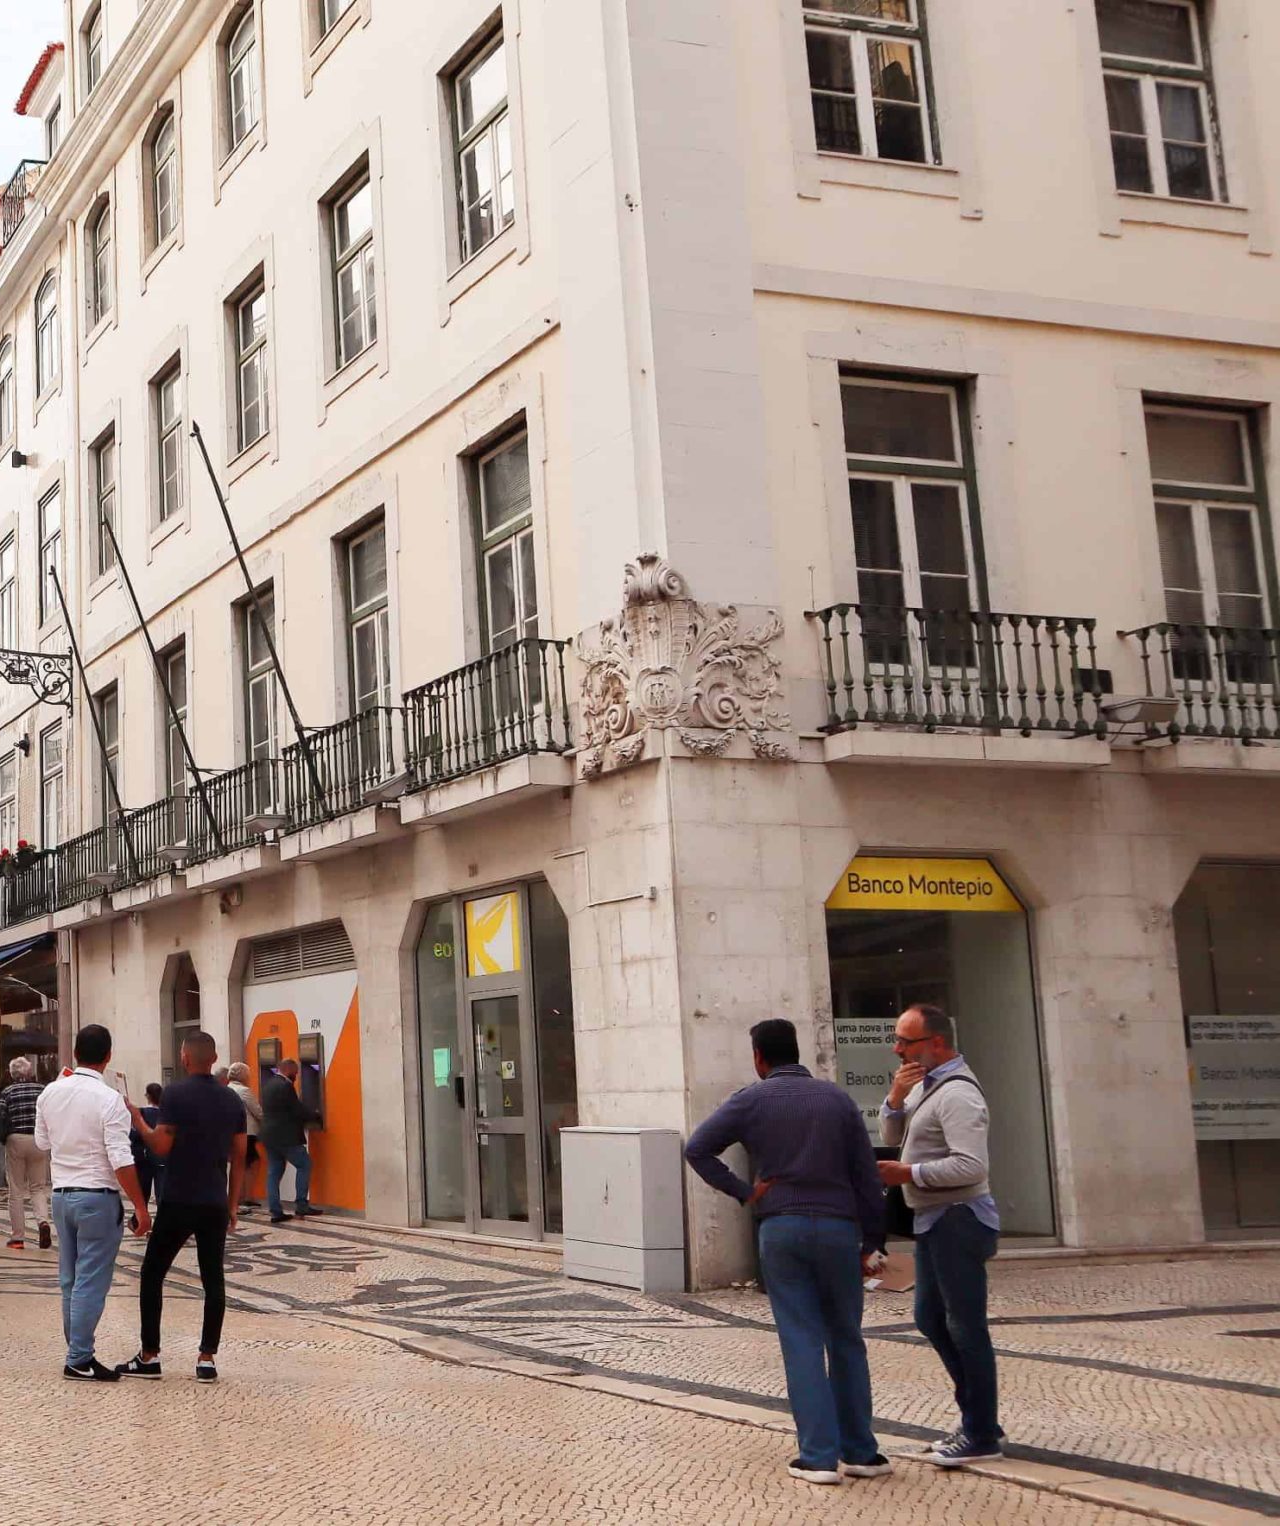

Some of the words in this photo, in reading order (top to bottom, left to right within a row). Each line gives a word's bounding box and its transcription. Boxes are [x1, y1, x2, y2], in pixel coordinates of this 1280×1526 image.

[847, 873, 904, 894] Banco
[908, 874, 994, 901] Montepio
[836, 1024, 857, 1033] uma
[859, 1024, 882, 1033] nova
[850, 1034, 882, 1045] valores
[845, 1071, 885, 1086] Banco
